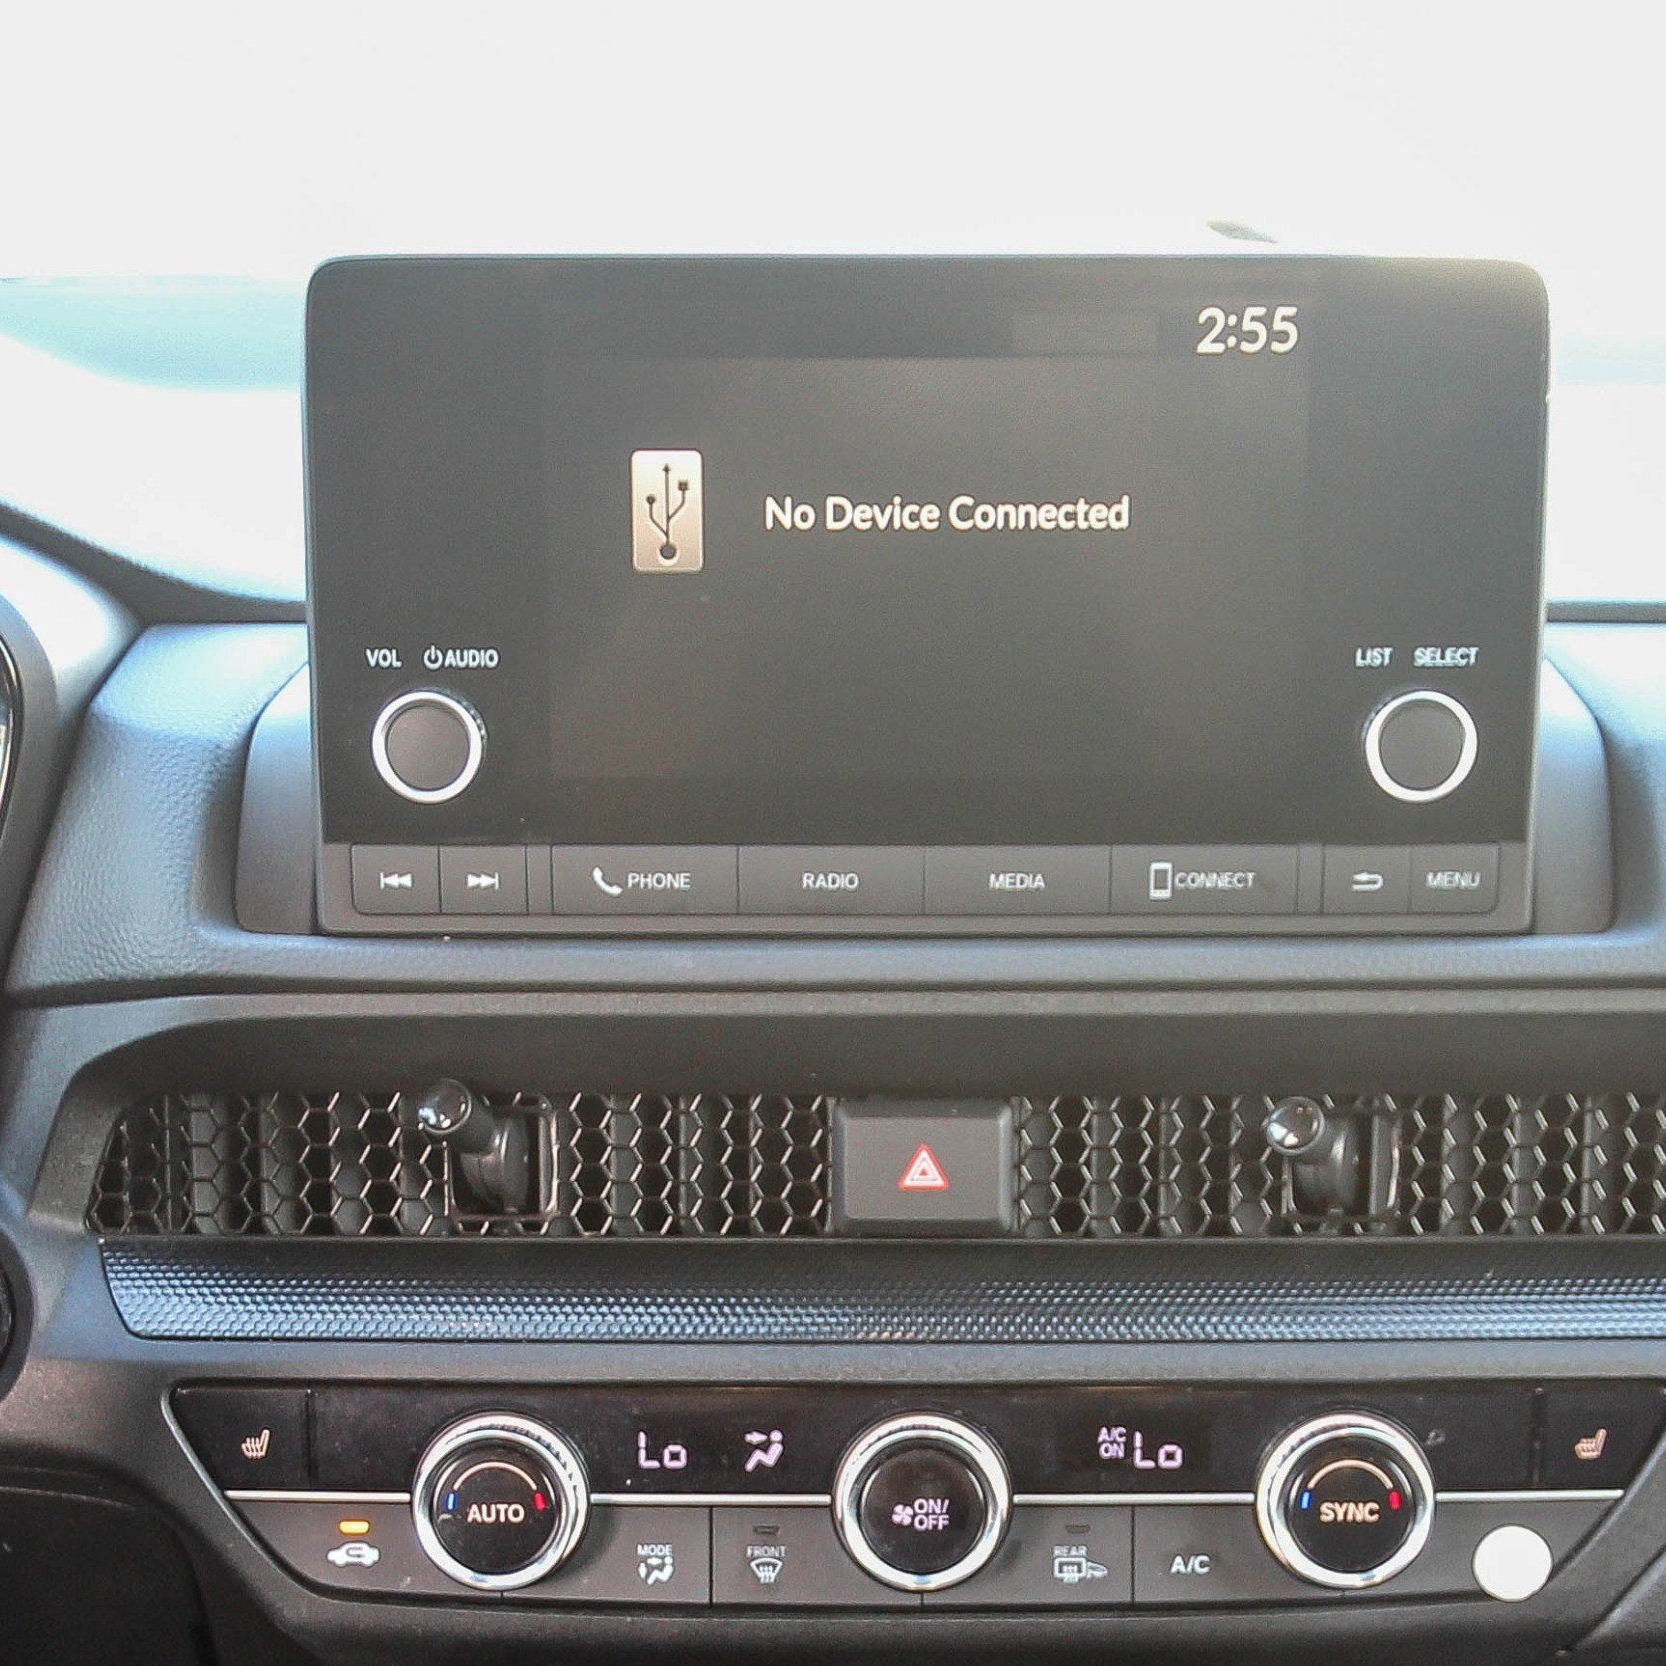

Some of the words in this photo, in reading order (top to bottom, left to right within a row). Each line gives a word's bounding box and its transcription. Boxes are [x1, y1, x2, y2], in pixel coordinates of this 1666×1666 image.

[1195, 307, 1299, 354] 2:55
[764, 497, 815, 530] No
[825, 496, 939, 531] Device
[948, 495, 1129, 532] Connected
[365, 648, 402, 668] VOL
[444, 648, 499, 668] AUDIO
[1355, 647, 1393, 667] LIST
[1414, 647, 1479, 667] SELECT
[627, 871, 691, 889] PHONE
[802, 871, 859, 890] RADIO
[989, 871, 1046, 890] MEDIA
[1175, 871, 1256, 889] CONNECT
[1426, 871, 1481, 888] MENU
[1097, 1427, 1126, 1443] A/C
[1099, 1443, 1125, 1460] ON
[467, 1504, 525, 1523] AUTO
[1319, 1502, 1379, 1523] SYNC
[914, 1515, 949, 1531] OFF
[637, 1545, 673, 1556] MODE
[746, 1546, 786, 1557] FRONT
[1053, 1546, 1087, 1557] REAR
[1170, 1556, 1210, 1574] A/C
